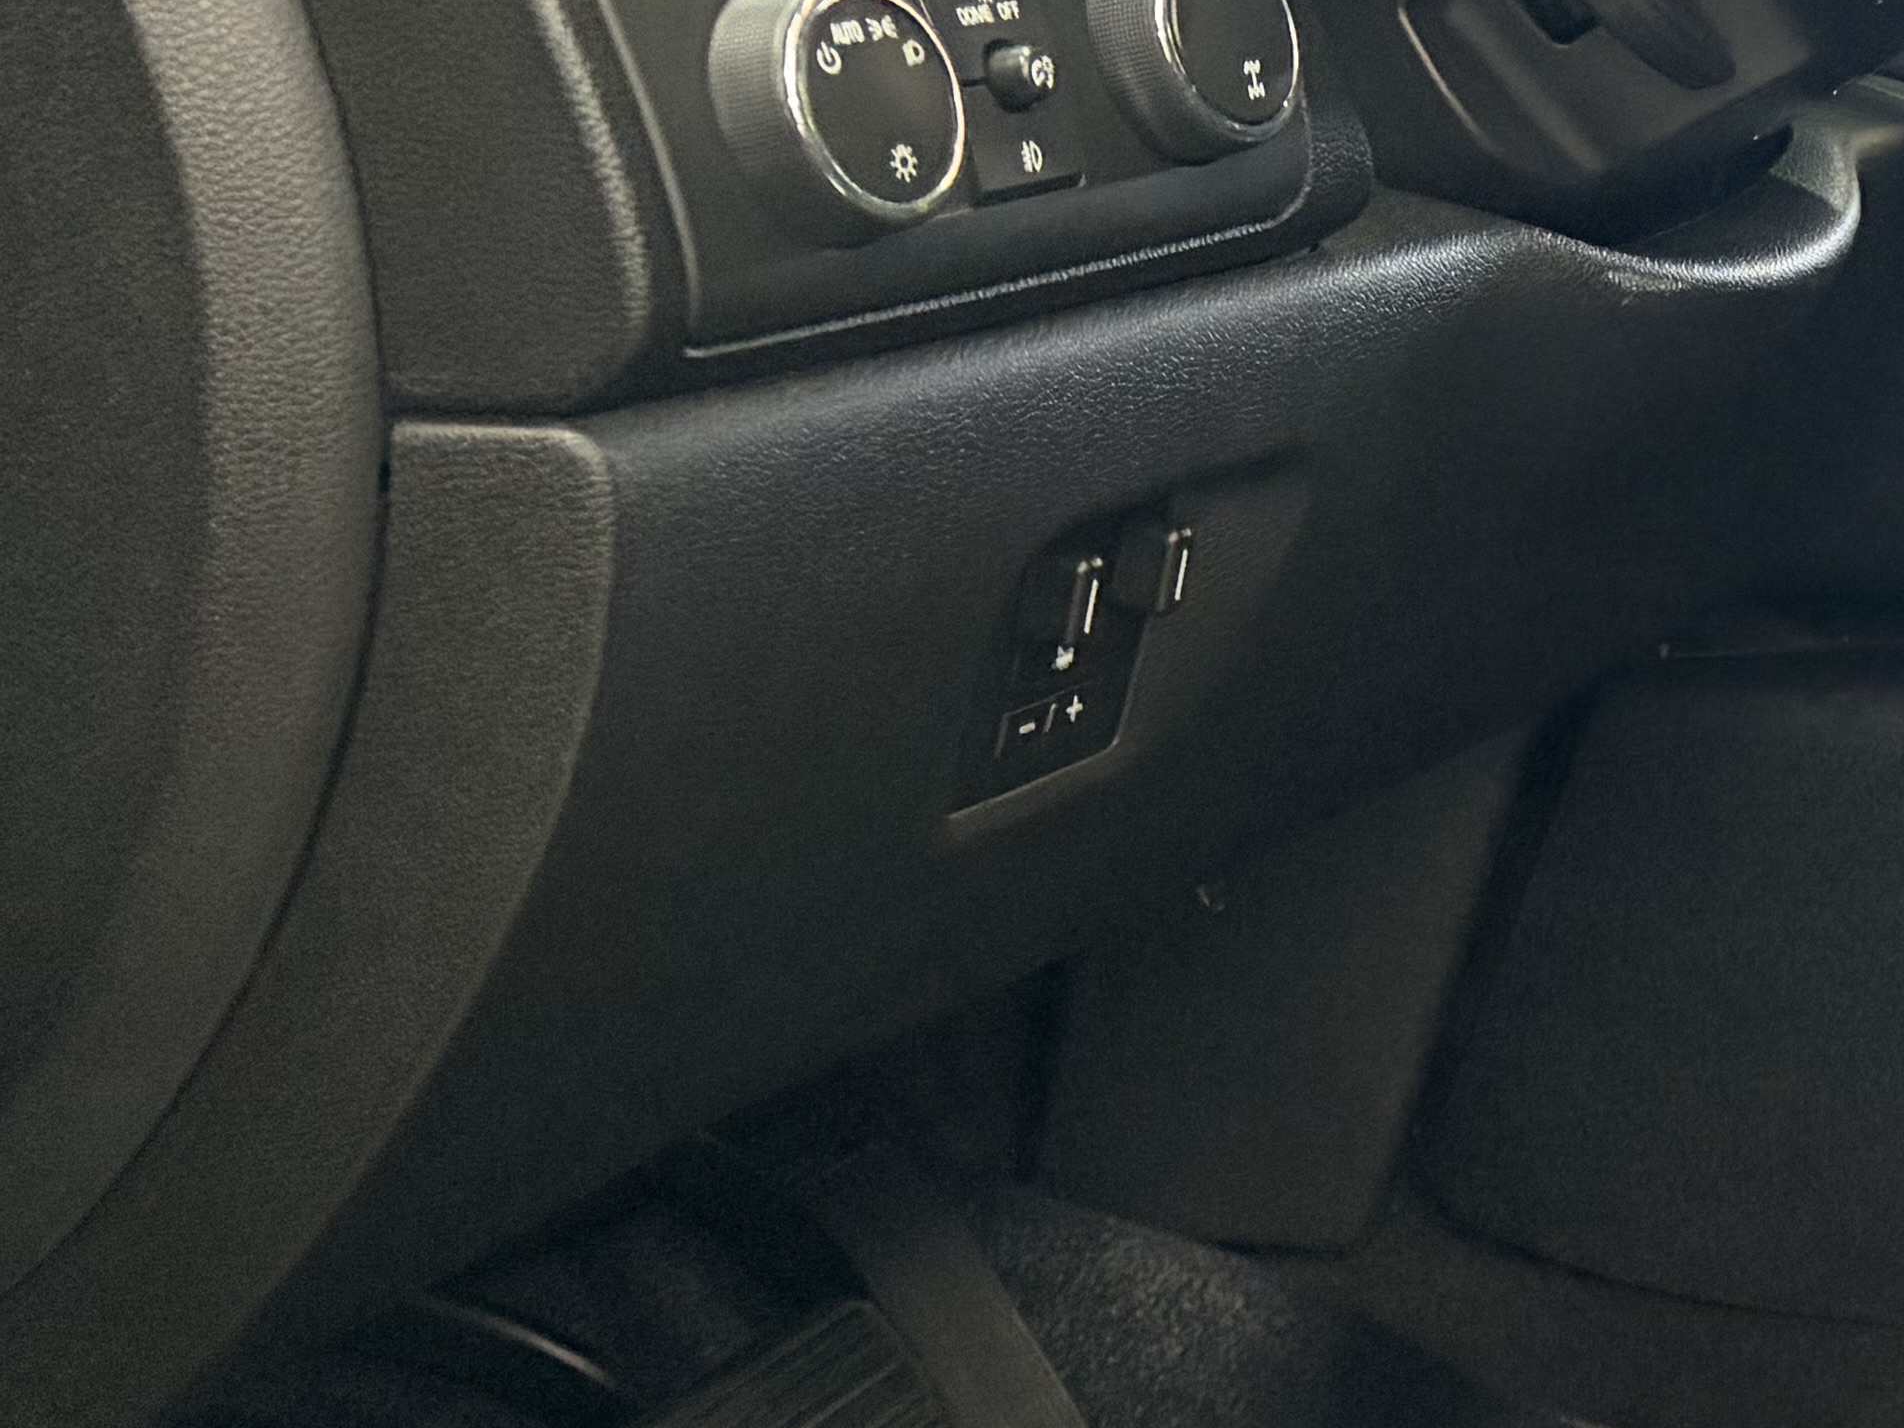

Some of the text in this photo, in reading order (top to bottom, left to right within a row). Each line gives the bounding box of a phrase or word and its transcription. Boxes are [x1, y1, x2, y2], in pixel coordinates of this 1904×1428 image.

[955, 0, 1020, 27] DOME OFF
[829, 19, 866, 46] AUTO
